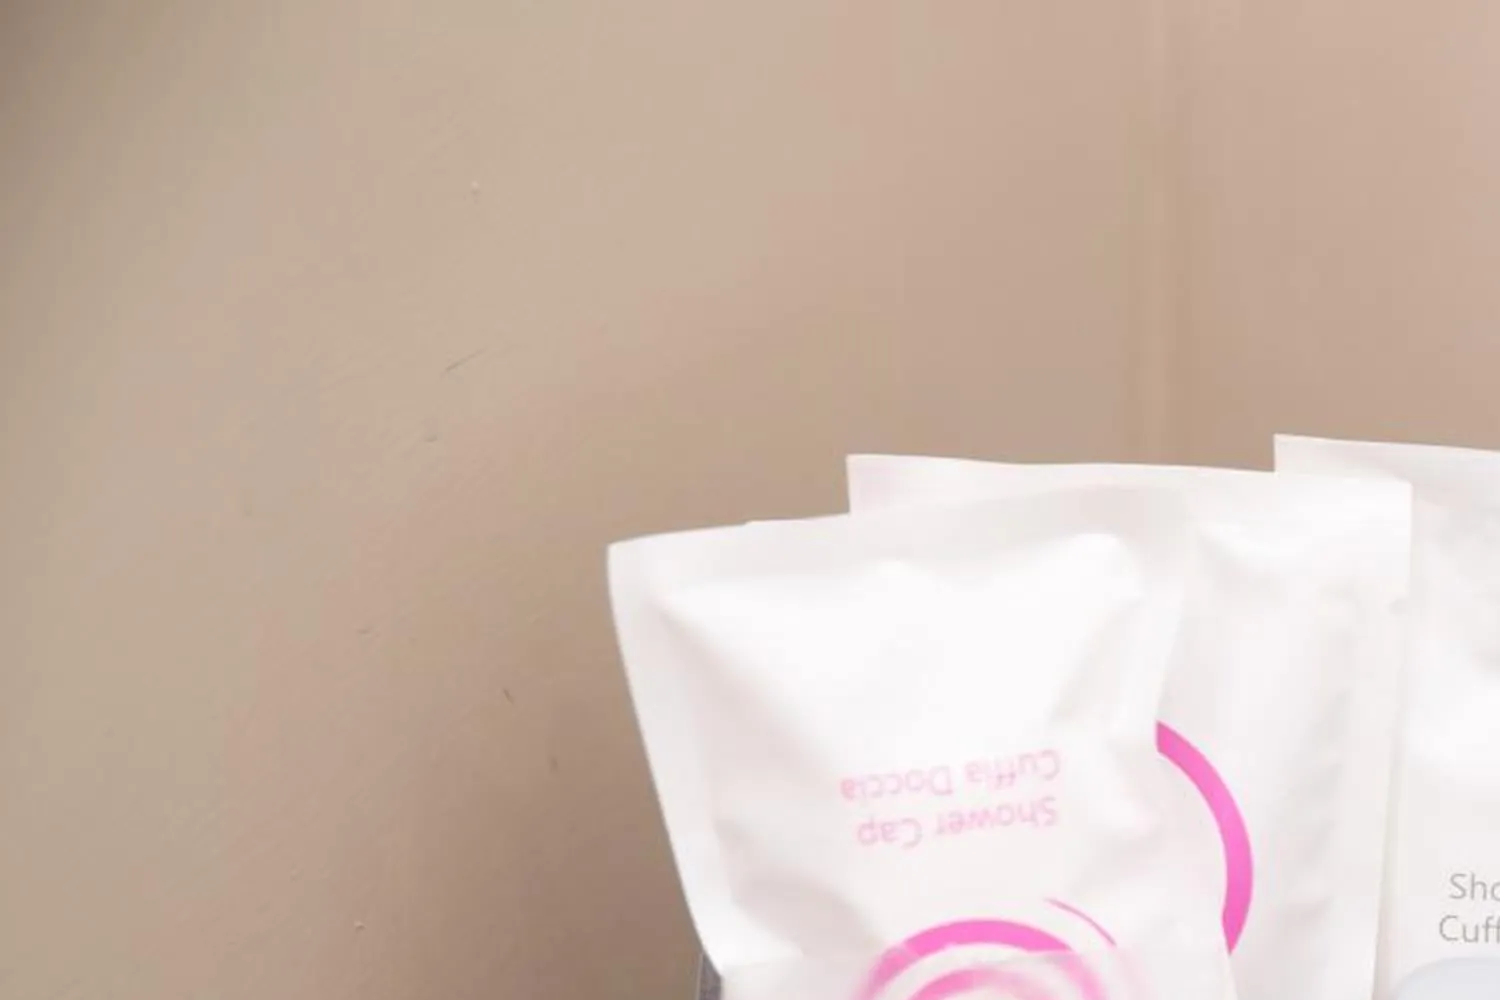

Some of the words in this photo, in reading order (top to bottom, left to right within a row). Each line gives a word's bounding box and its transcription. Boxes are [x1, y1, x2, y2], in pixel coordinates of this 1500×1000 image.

[840, 765, 954, 804] Doccia
[964, 749, 1061, 790] Cuffia
[857, 814, 923, 849] Cap
[934, 796, 1059, 837] Shower
